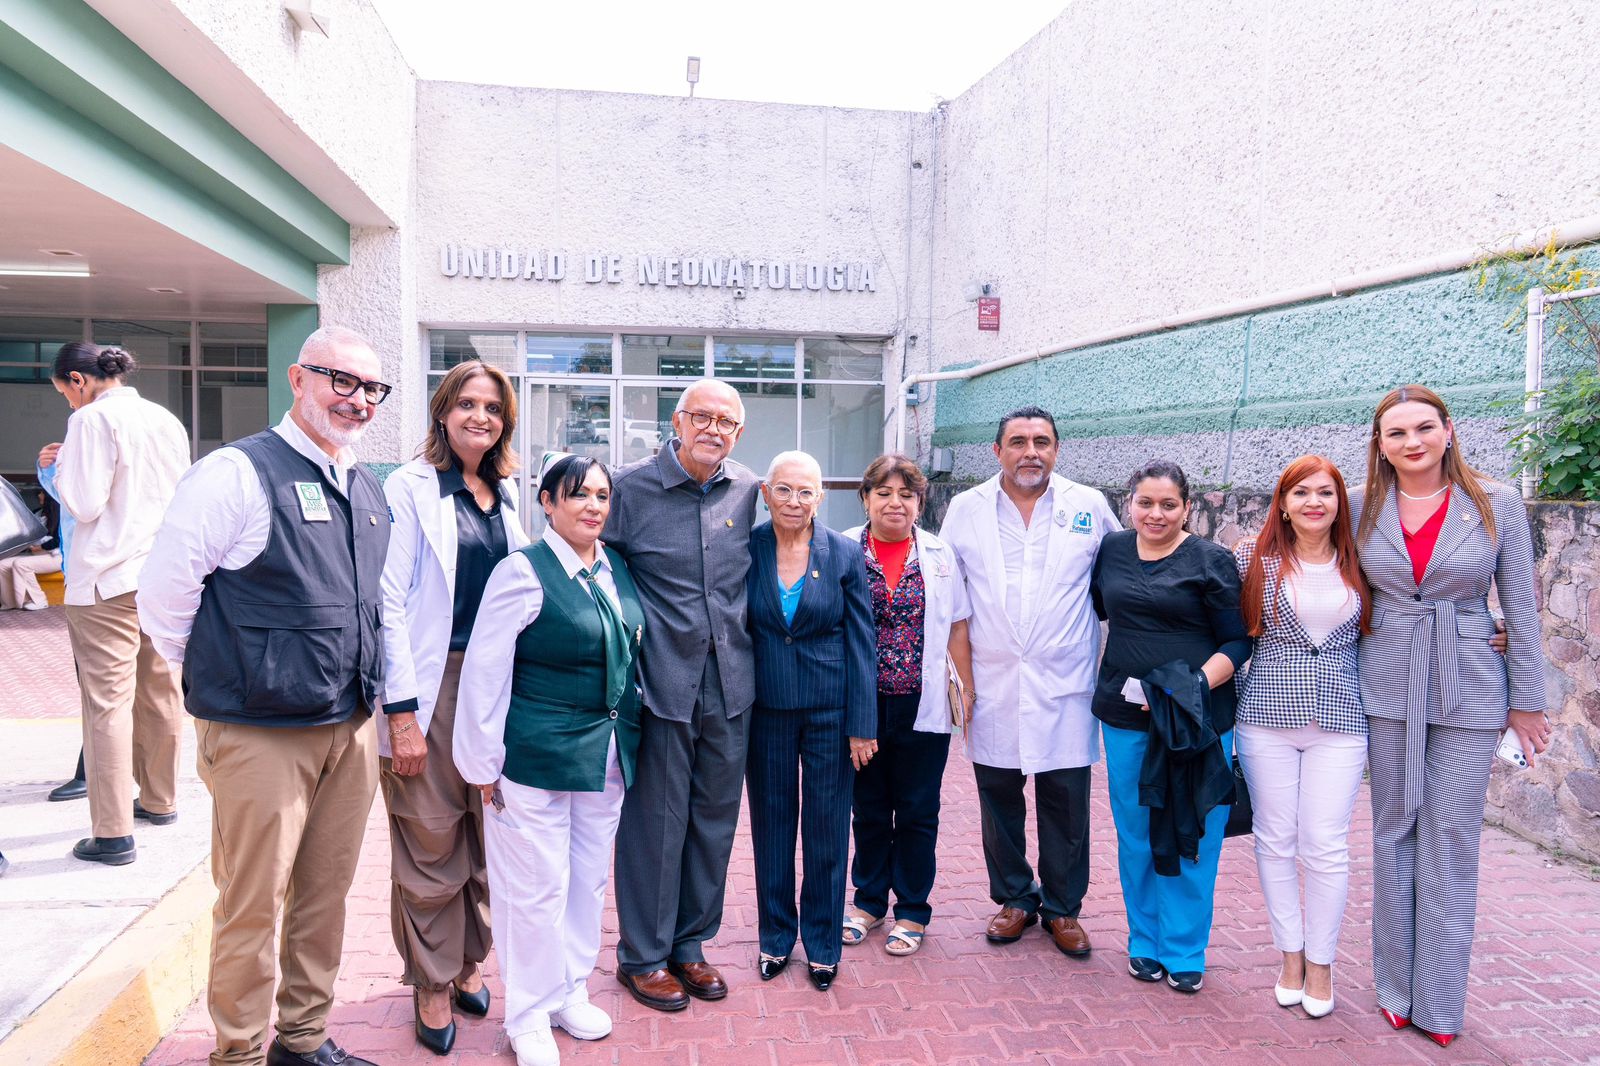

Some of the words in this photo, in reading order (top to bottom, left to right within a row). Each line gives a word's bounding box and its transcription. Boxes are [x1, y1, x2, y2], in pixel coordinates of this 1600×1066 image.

[440, 244, 565, 280] UNIDAD
[585, 253, 622, 284] DE
[638, 256, 875, 292] NEONATOLOGIA
